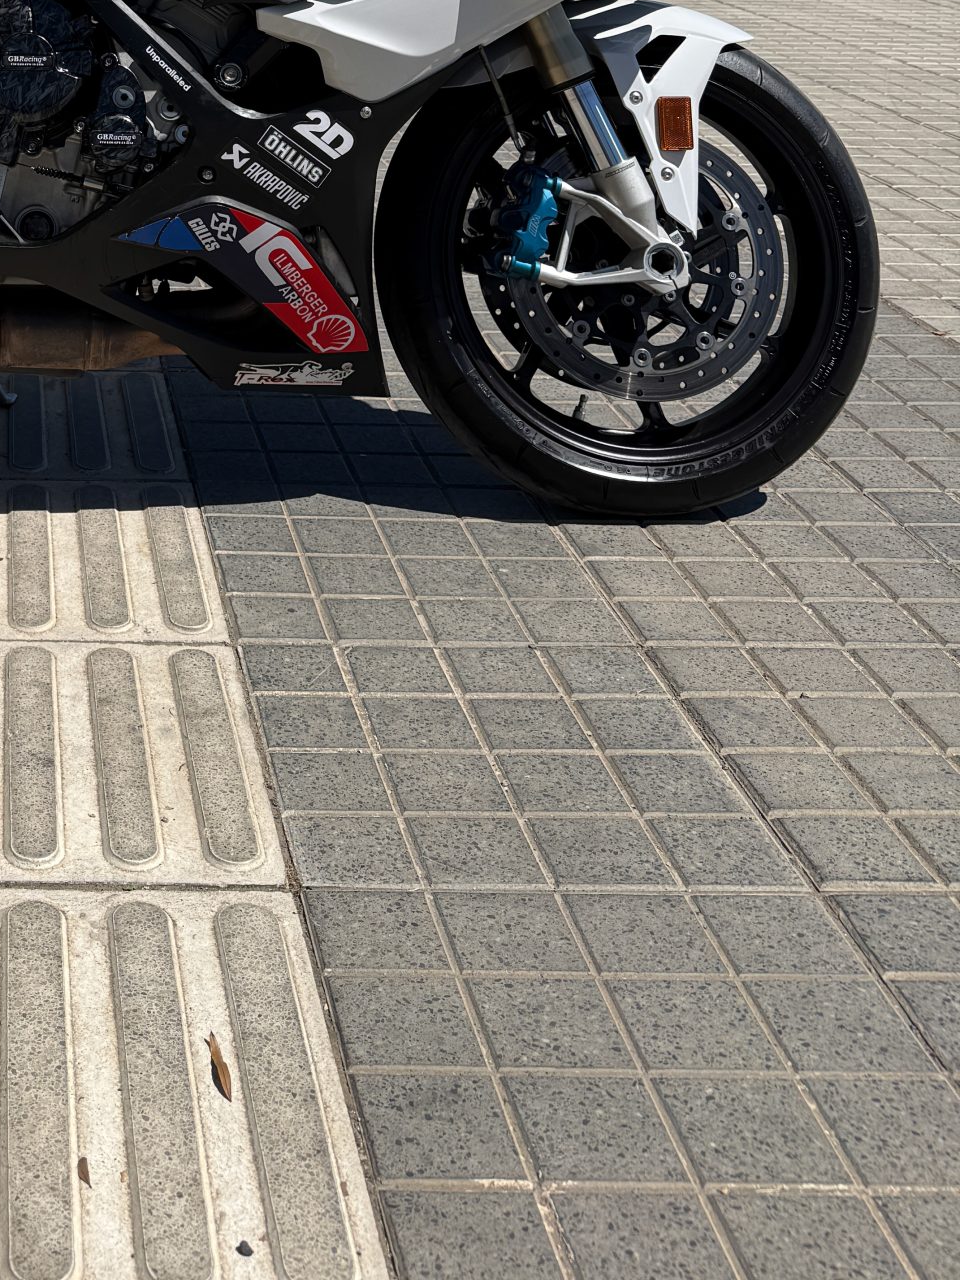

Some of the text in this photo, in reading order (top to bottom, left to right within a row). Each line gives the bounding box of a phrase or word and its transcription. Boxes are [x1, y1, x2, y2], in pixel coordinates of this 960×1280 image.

[145, 45, 191, 91] Unparalleled
[263, 130, 323, 182] ÖHLINS
[293, 109, 354, 159] 2D
[187, 217, 220, 252] GILLES
[273, 253, 328, 317] ILMBERGER
